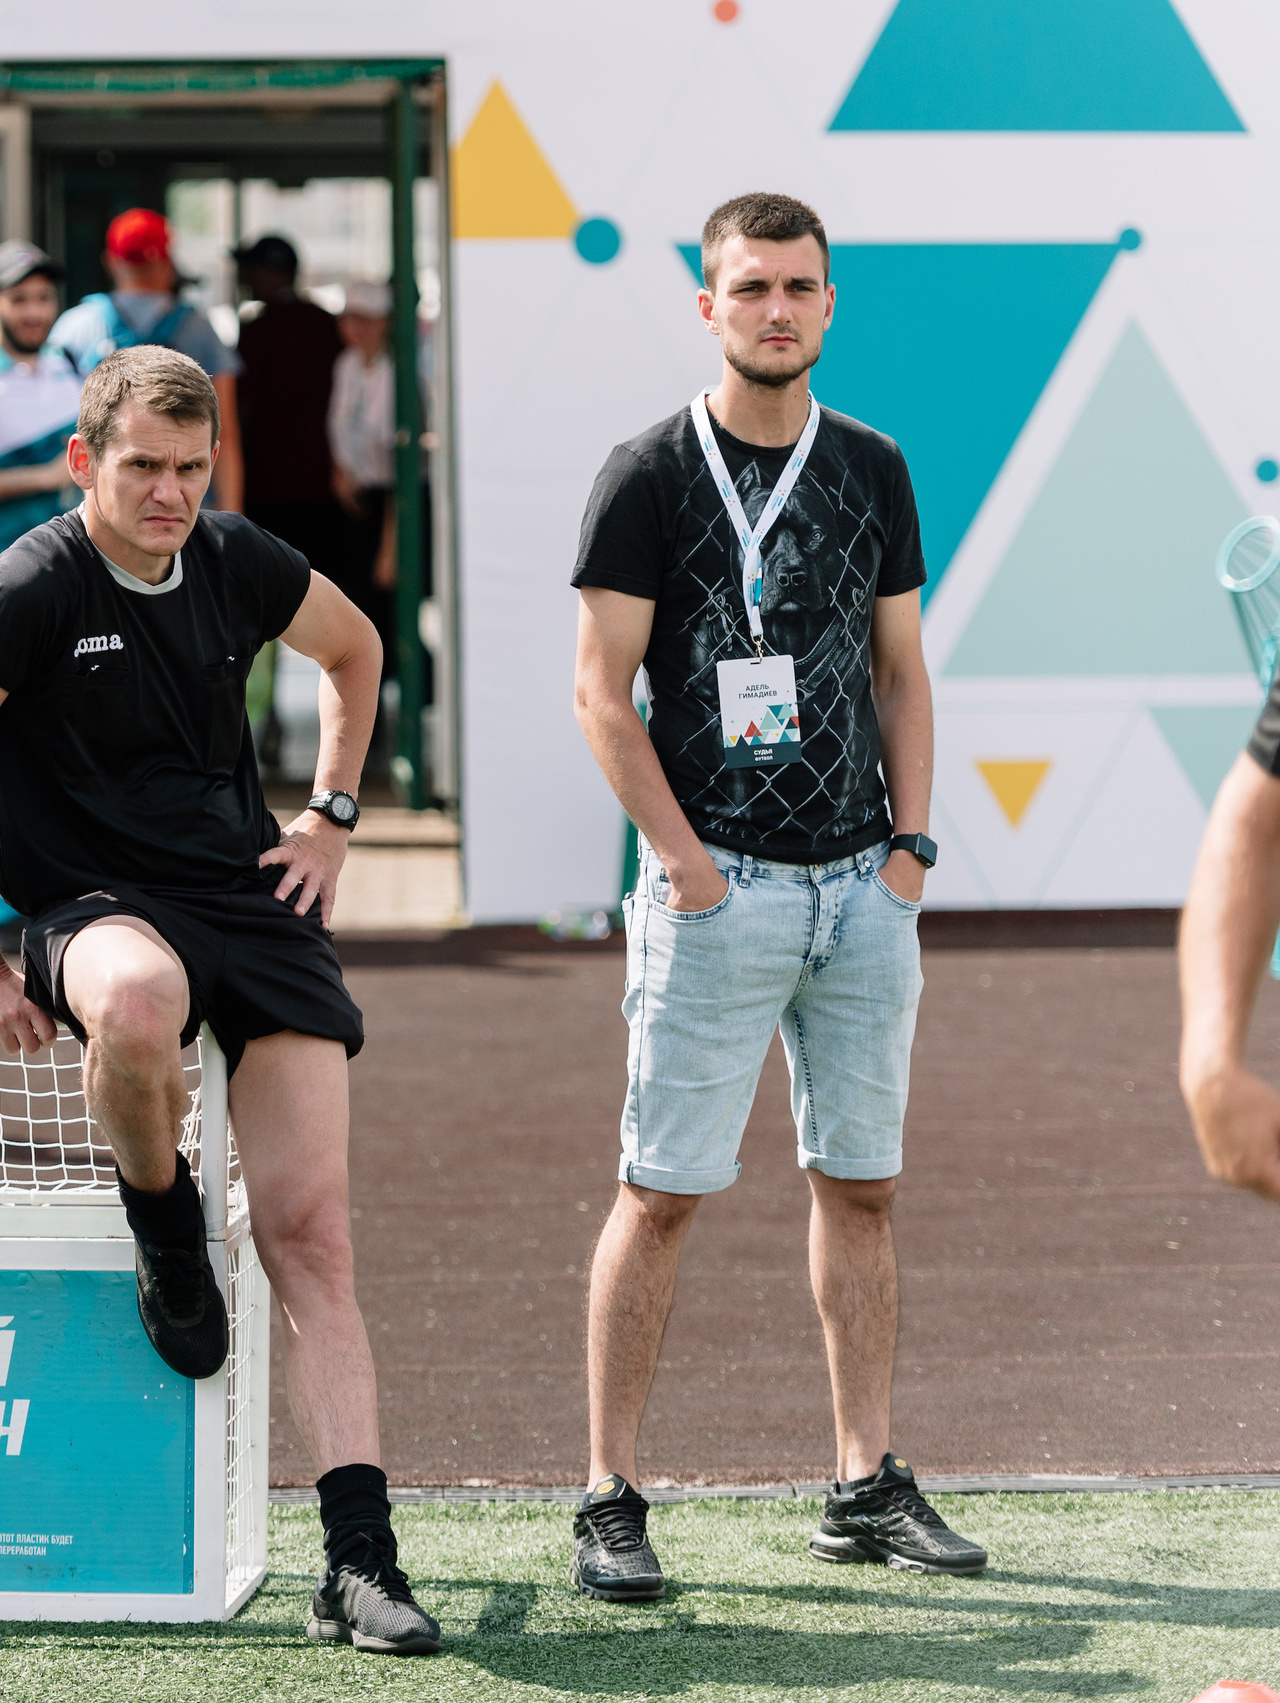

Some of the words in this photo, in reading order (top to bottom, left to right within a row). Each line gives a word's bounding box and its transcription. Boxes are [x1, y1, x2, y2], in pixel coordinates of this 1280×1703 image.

[74, 634, 124, 658] oma
[745, 684, 770, 692] АДЕЛЬ
[738, 690, 778, 699] ГИМАДИЕВ
[753, 748, 773, 756] СУДЬЯ
[16, 1533, 50, 1544] ПЛАСТИК
[51, 1534, 74, 1545] БУДЕТ
